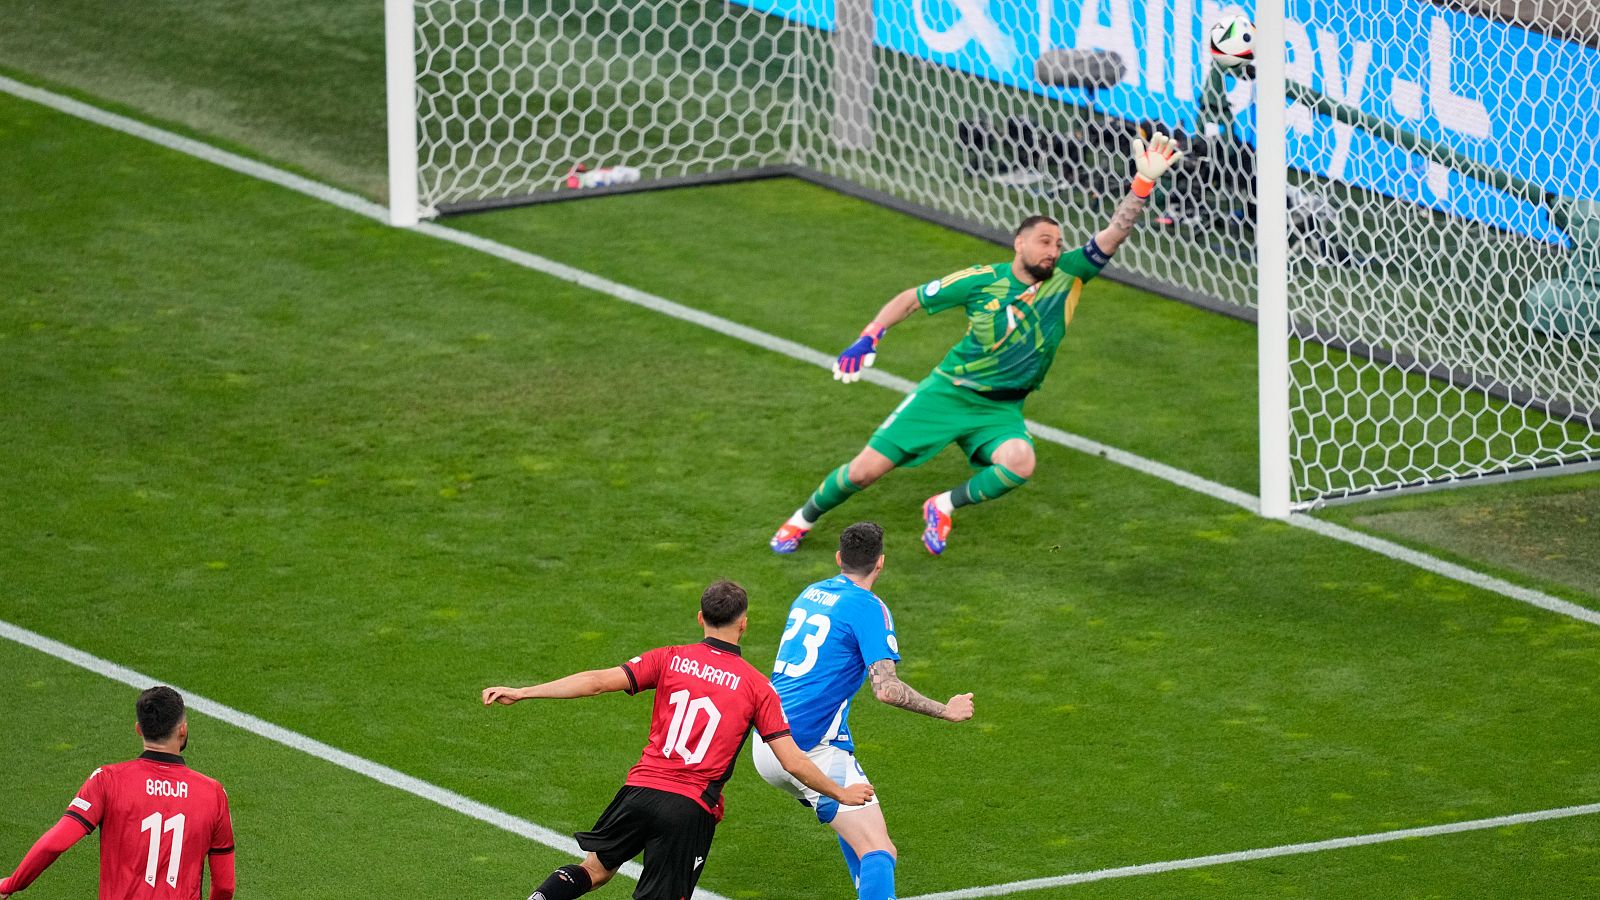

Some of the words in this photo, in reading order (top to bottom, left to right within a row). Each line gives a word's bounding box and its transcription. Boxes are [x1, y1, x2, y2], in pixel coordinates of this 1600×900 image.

[669, 655, 741, 691] N.BAJRAMI
[773, 607, 831, 678] 23
[662, 689, 722, 765] 10
[146, 778, 188, 798] BROJA
[141, 811, 186, 889] 11
